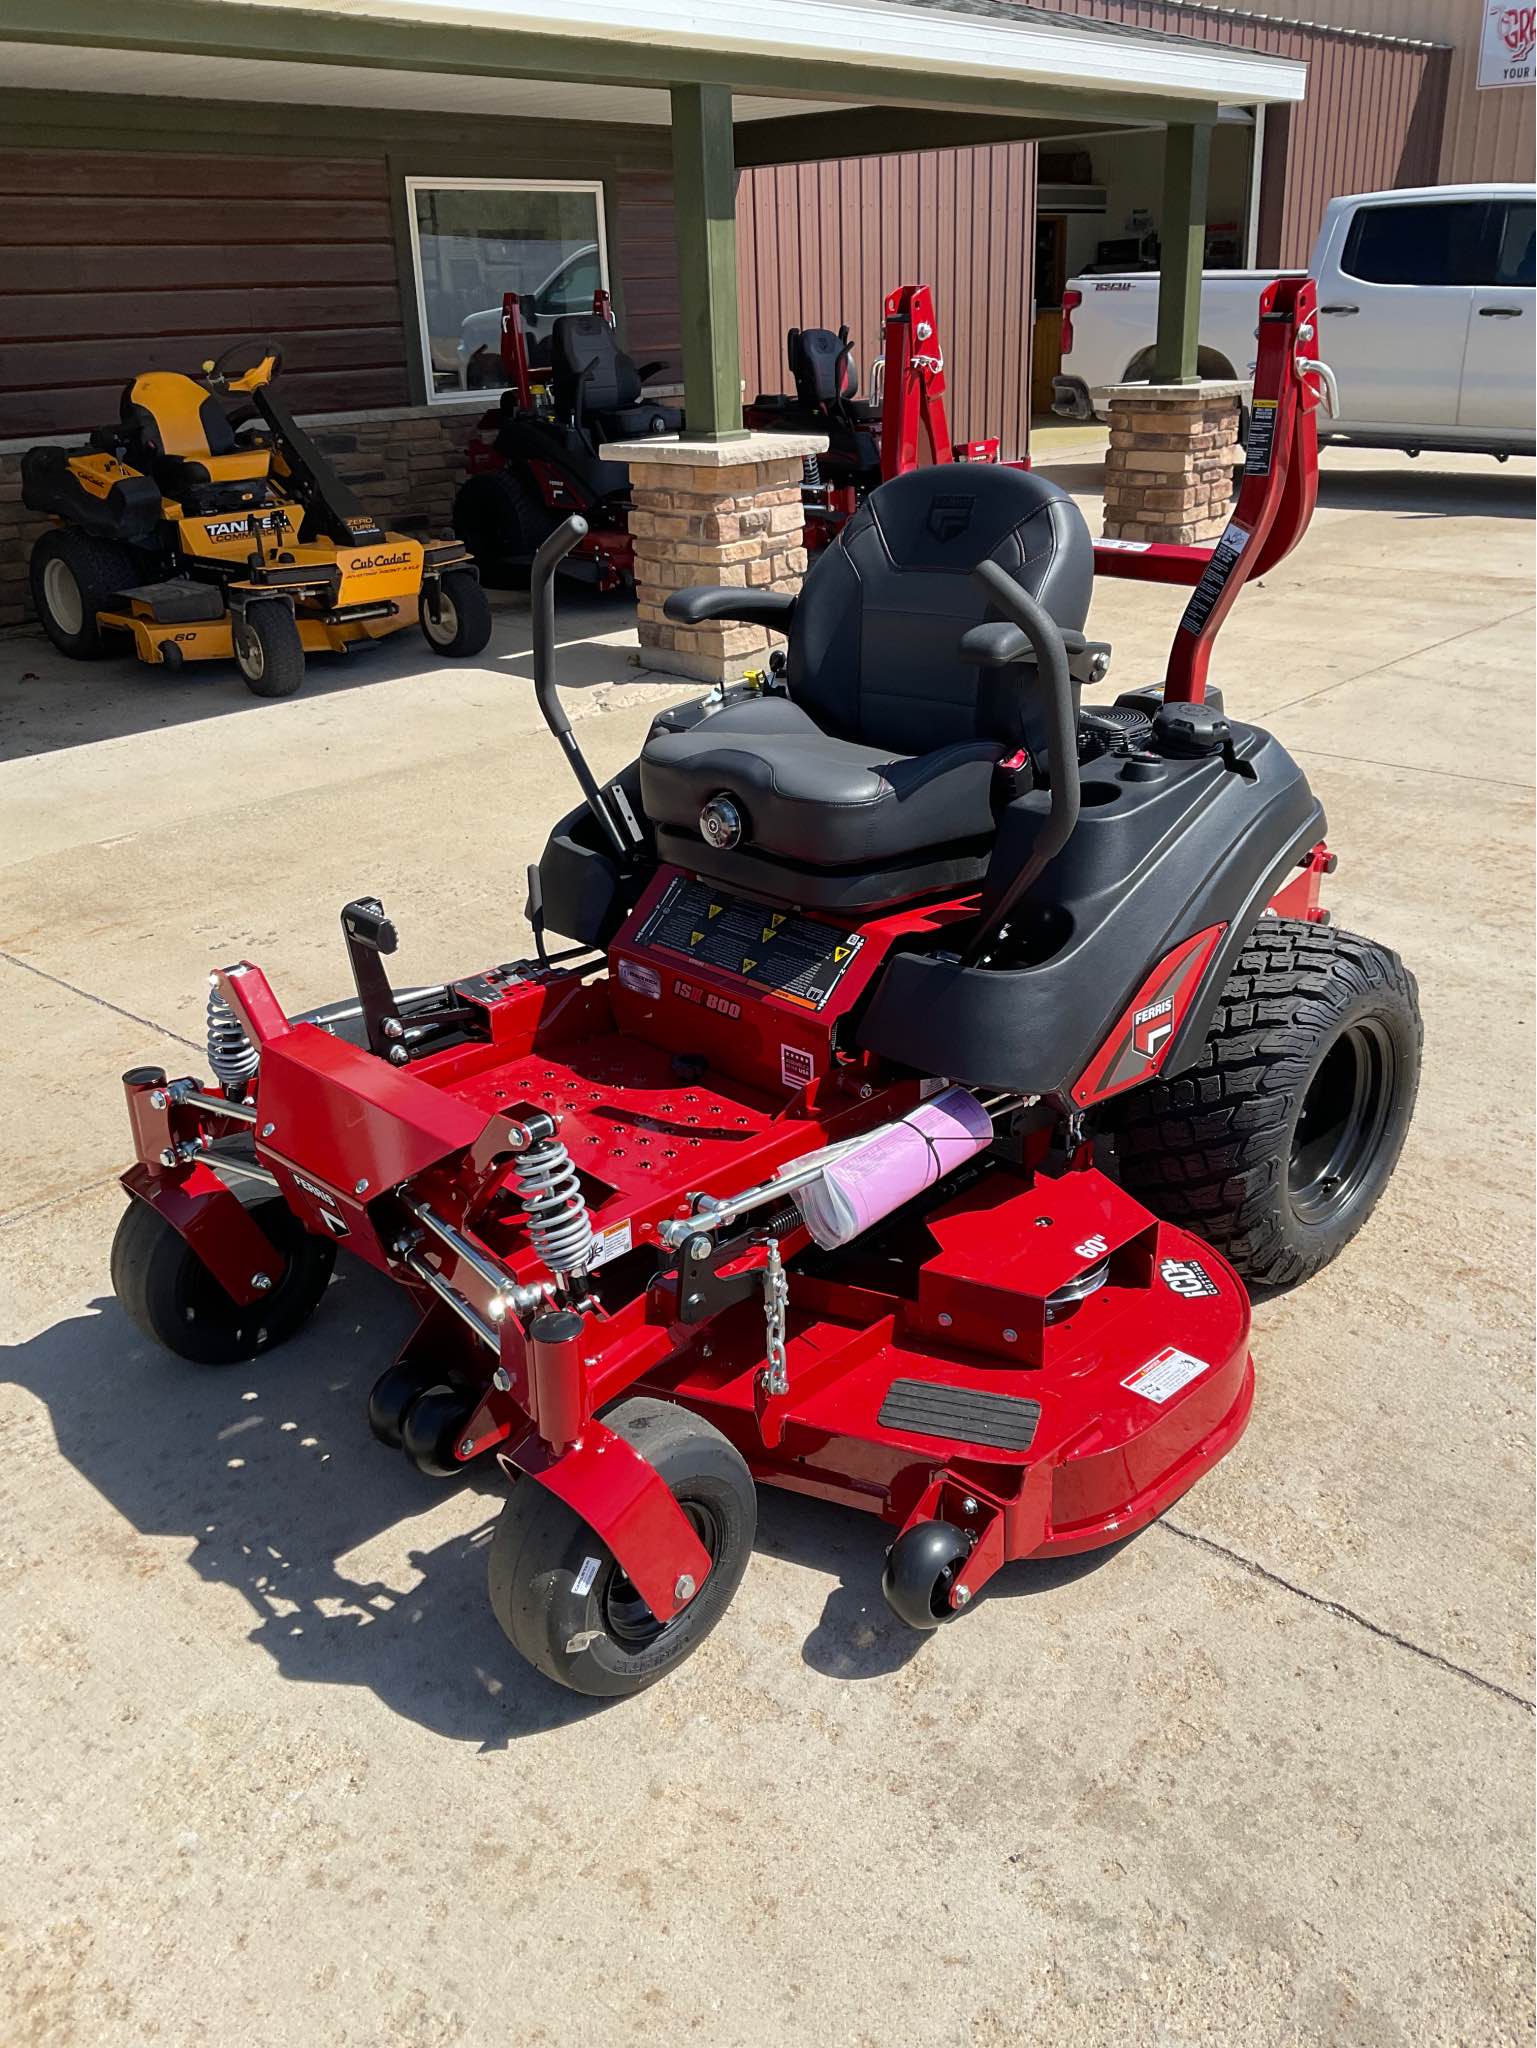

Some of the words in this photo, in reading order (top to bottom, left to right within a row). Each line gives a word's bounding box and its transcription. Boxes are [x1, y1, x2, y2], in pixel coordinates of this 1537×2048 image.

[1503, 67, 1530, 79] YOUR
[206, 519, 256, 535] TAN
[345, 517, 373, 526] ZERO
[348, 523, 376, 532] TURN
[351, 556, 373, 570] Cub
[374, 552, 411, 567] Cadet
[174, 632, 197, 641] 60
[706, 993, 741, 1019] 800
[1135, 999, 1172, 1025] FERRIS
[292, 1173, 336, 1207] FERRIS
